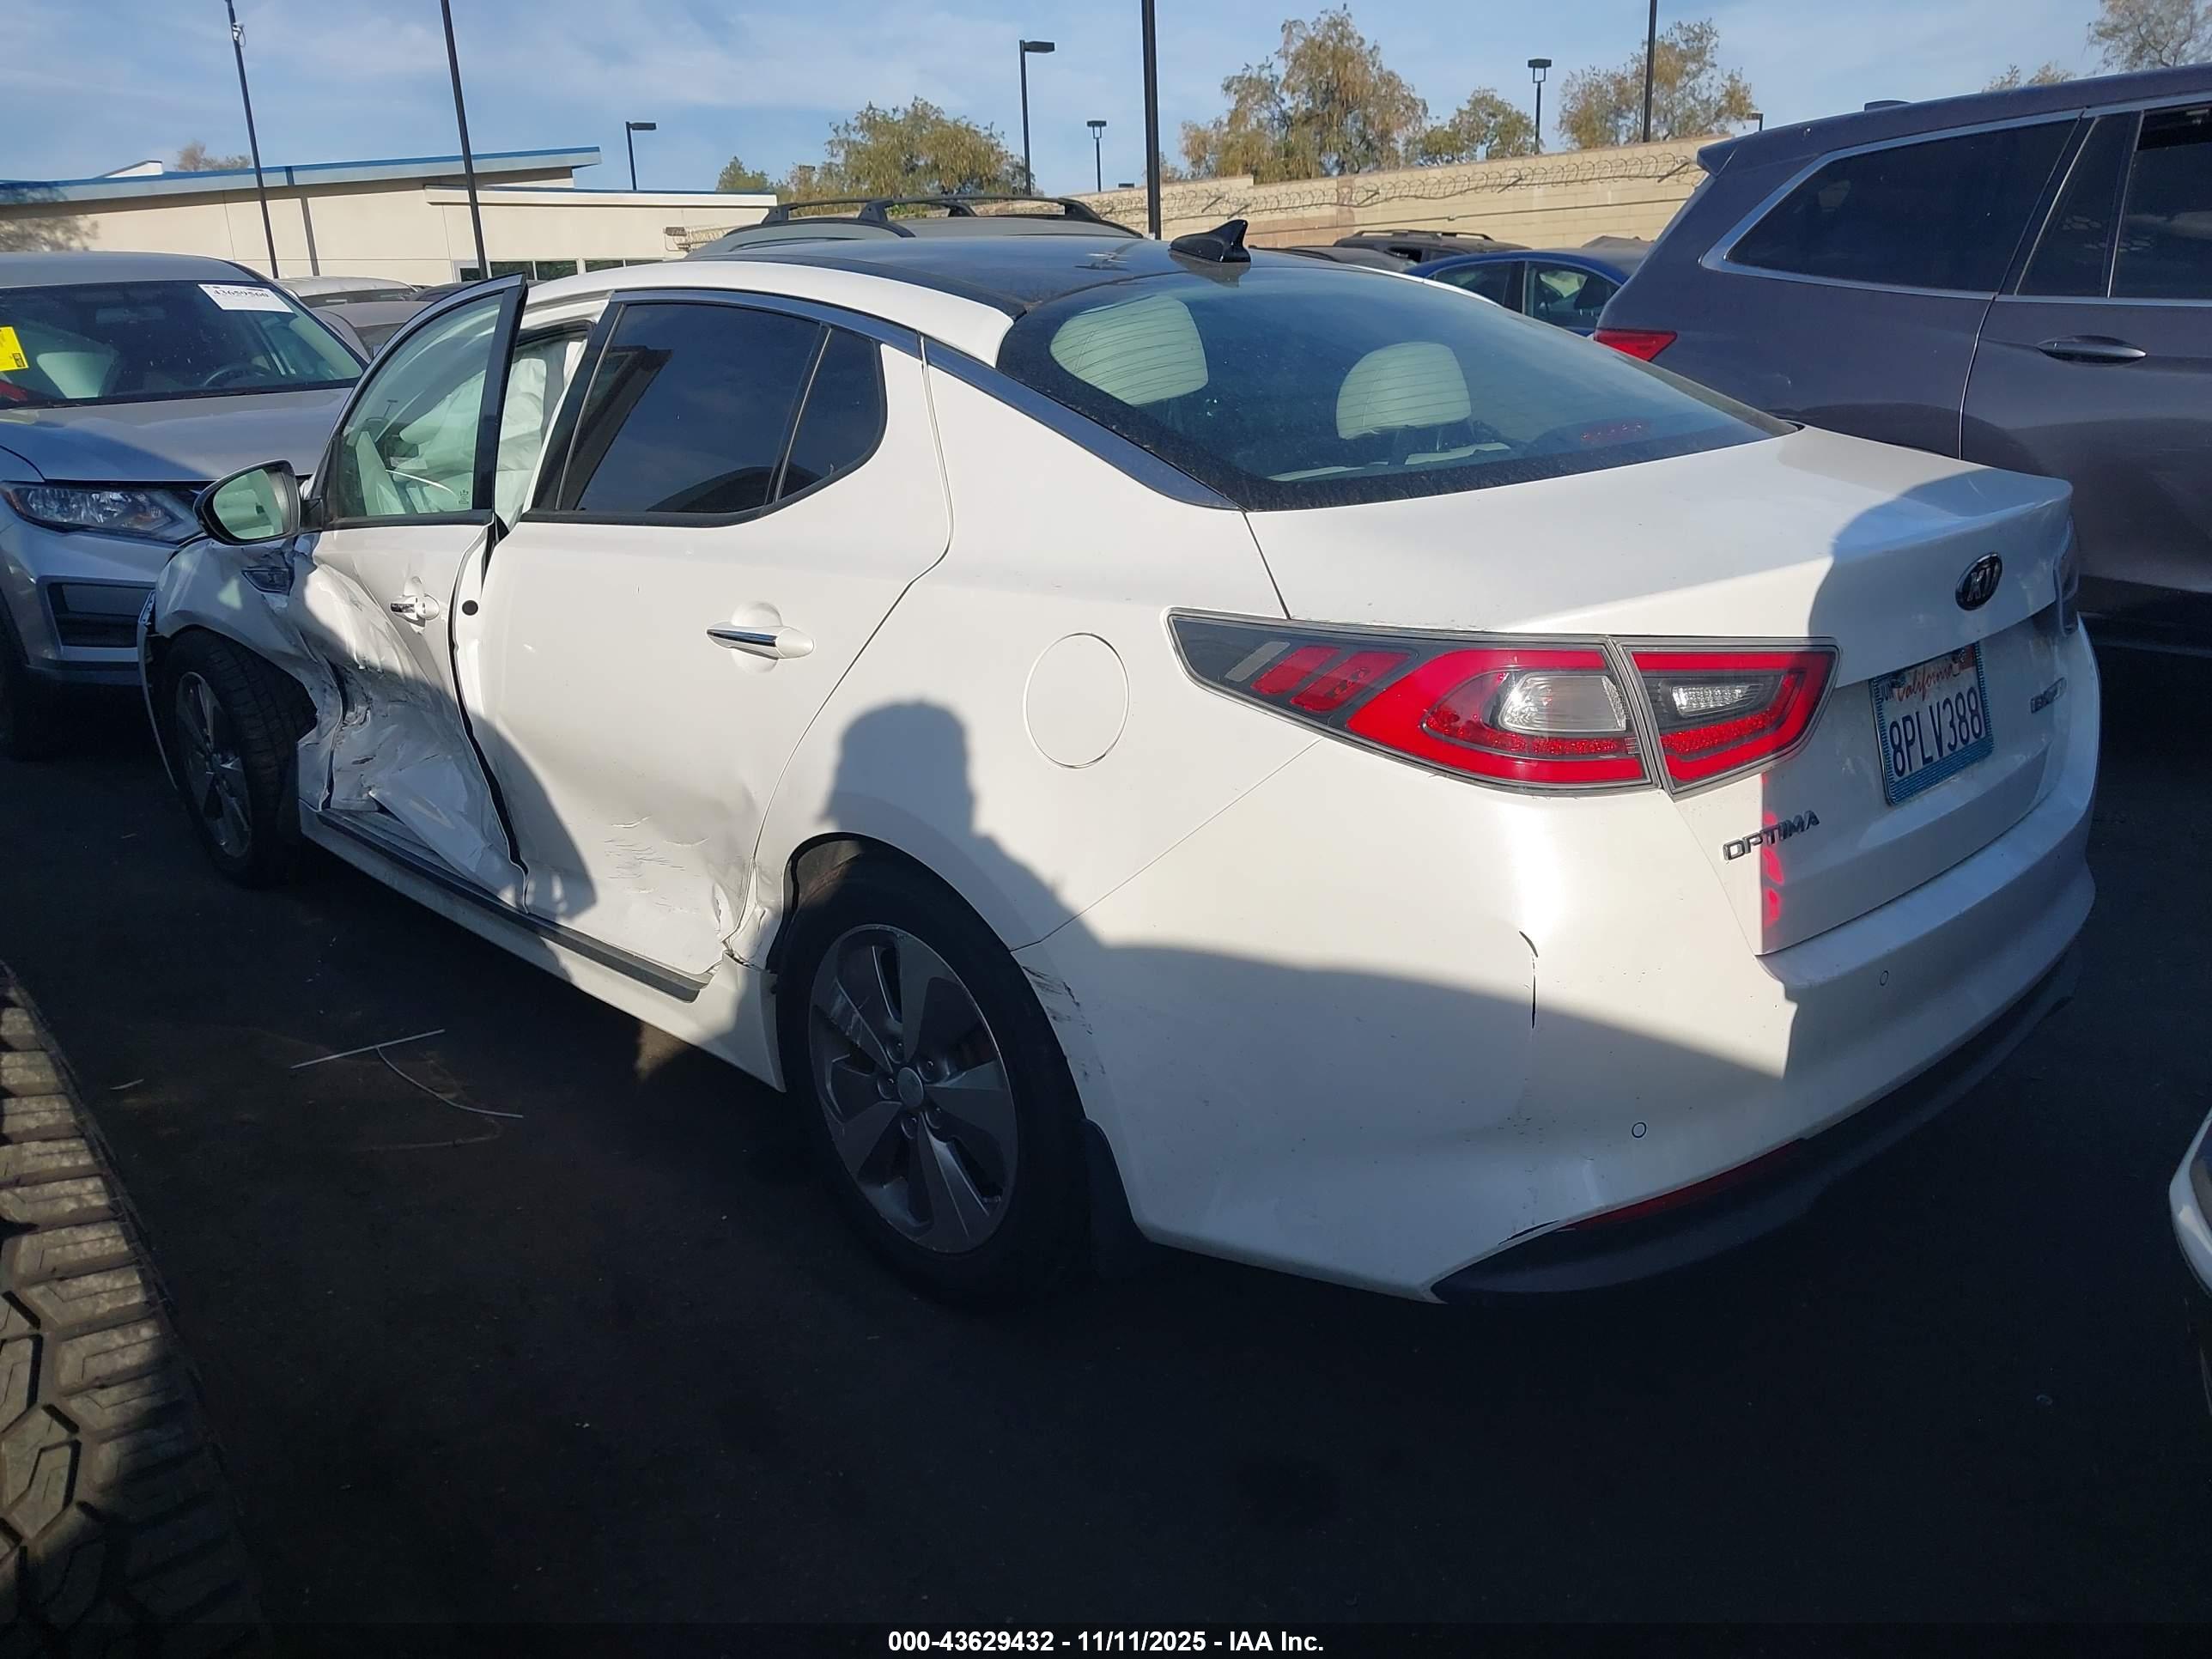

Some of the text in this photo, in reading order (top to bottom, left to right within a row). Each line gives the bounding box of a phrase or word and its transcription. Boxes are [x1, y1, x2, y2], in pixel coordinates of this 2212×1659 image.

[1896, 663, 1954, 702] California
[1889, 686, 1983, 777] 8PLV388
[1723, 810, 1820, 860] OPTIMA
